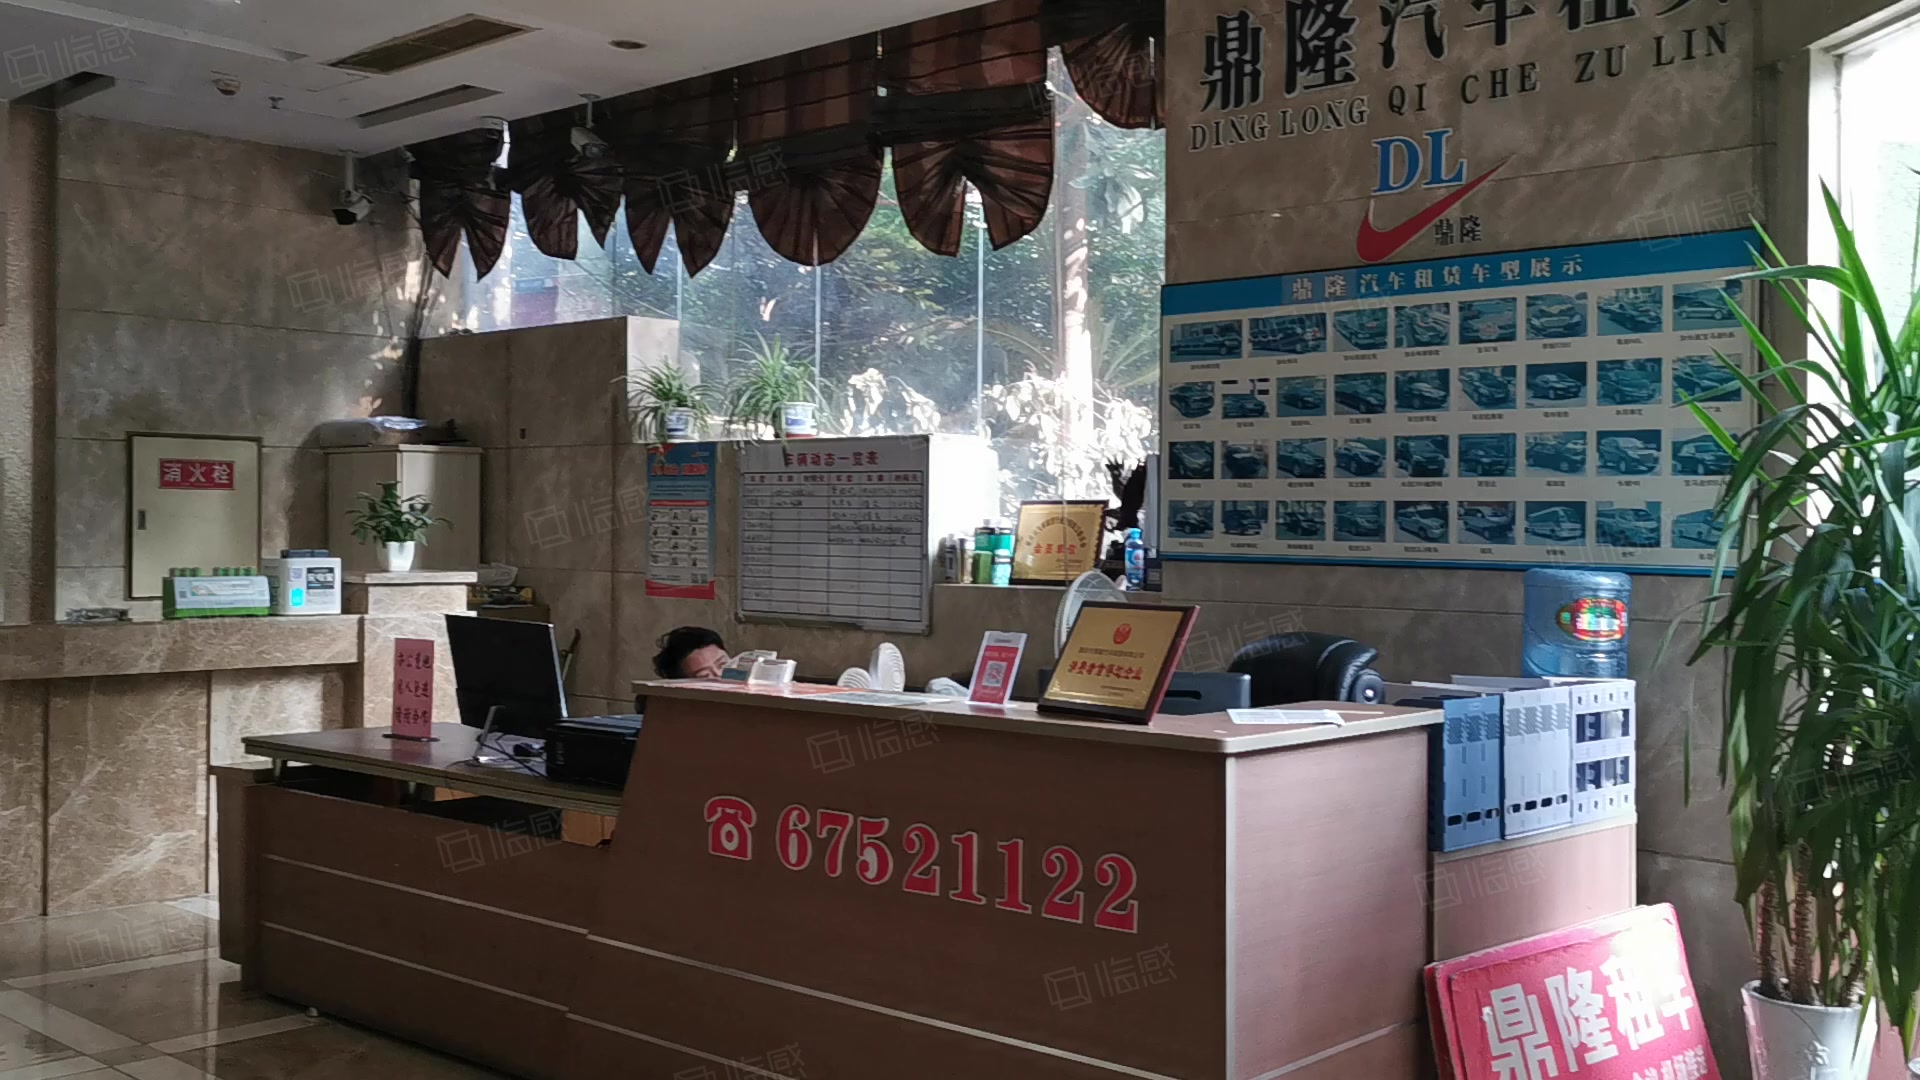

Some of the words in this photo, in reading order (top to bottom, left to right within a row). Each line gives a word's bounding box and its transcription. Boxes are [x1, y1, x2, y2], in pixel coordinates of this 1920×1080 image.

[1189, 111, 1269, 152] DING
[1278, 96, 1370, 138] LONG
[1388, 82, 1430, 116] QI
[1460, 61, 1541, 106] CHE
[1574, 44, 1628, 84] ZU
[1653, 22, 1730, 68] LIN
[1199, 0, 1730, 113] 鼎隆汽车
[1371, 128, 1468, 194] DL
[1432, 214, 1484, 245] 鼎隆
[1291, 254, 1584, 301] 鼎隆汽车租赁车型展示
[162, 462, 231, 484] 消火栓
[776, 803, 1140, 934] 67521122
